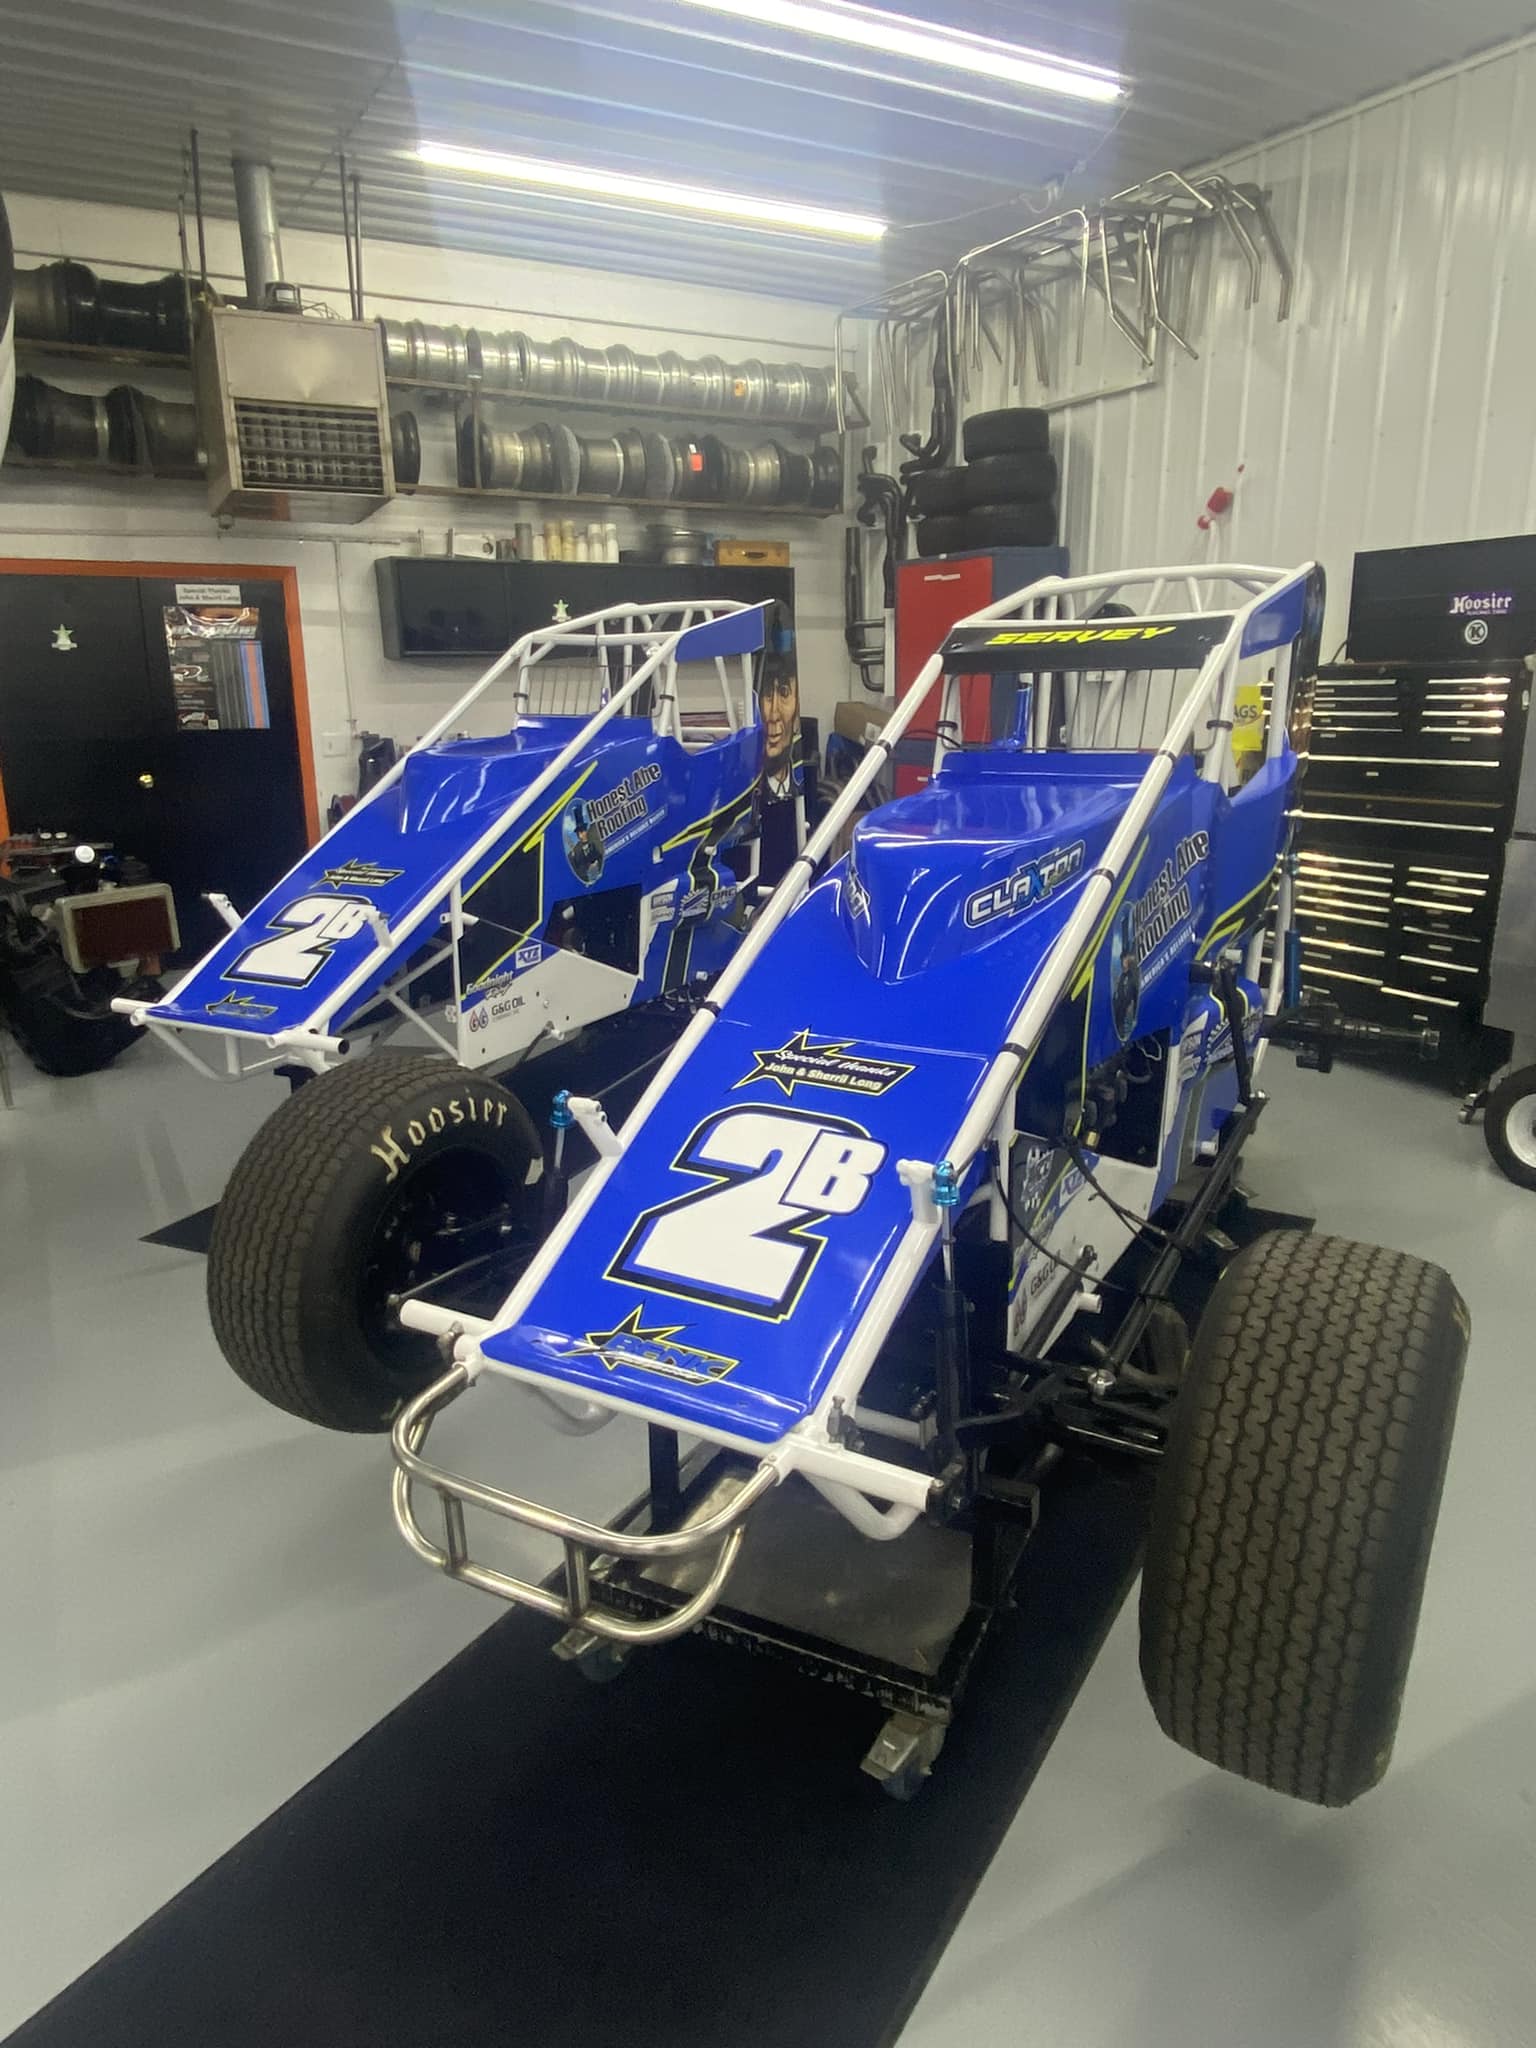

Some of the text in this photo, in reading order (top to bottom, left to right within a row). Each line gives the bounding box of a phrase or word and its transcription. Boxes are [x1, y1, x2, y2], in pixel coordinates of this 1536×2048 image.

[984, 626, 1176, 646] SERVEY
[586, 762, 662, 822] Honest Abe
[596, 794, 648, 839] Roofing
[1133, 858, 1177, 929] Honest
[1175, 830, 1209, 881] Abe
[228, 894, 376, 986] 2B
[1135, 882, 1191, 966] Roofing
[491, 999, 512, 1016] G&G
[511, 995, 526, 1009] OIL
[764, 1062, 795, 1076] John
[795, 1067, 807, 1077] &
[848, 1076, 883, 1091] Long
[370, 1086, 508, 1184] Hoosier
[626, 1108, 889, 1308] 2B
